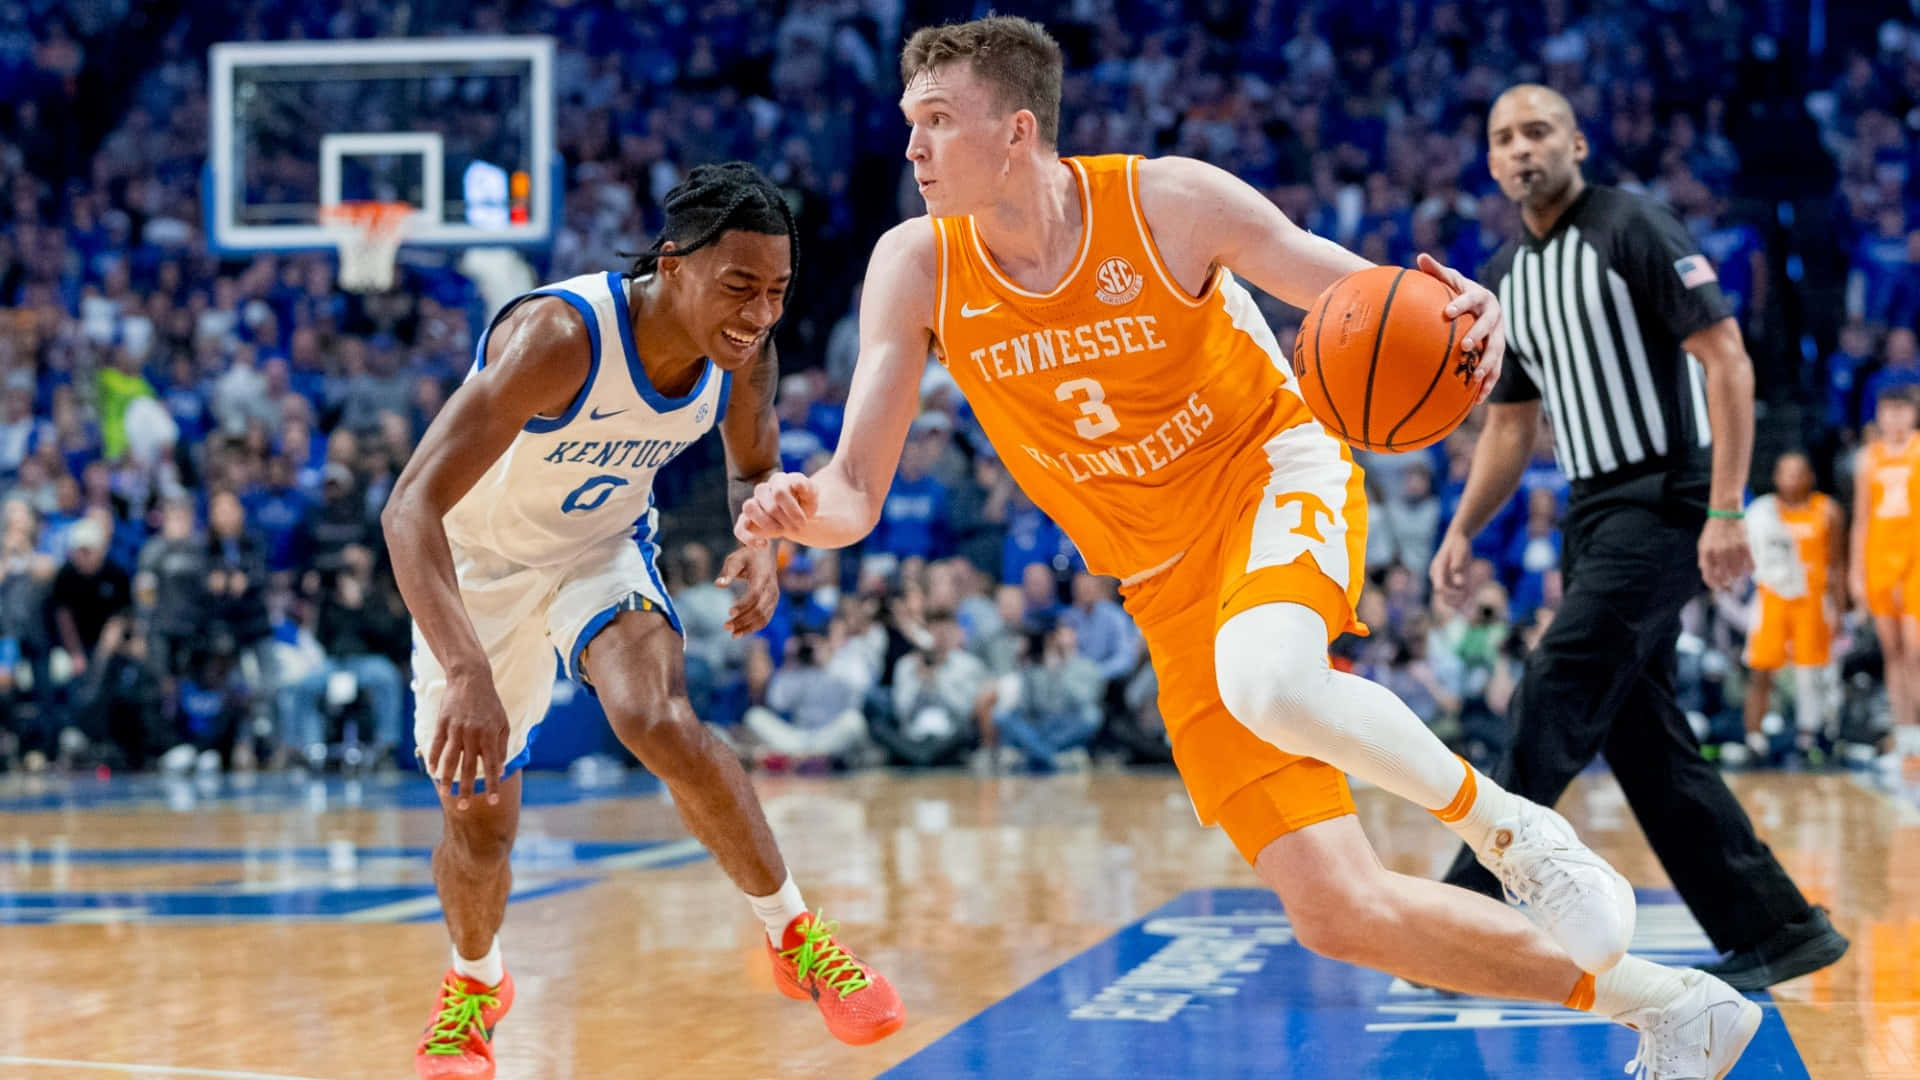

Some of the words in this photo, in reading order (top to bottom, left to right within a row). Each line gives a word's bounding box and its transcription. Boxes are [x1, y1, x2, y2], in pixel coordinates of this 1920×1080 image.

[1098, 259, 1133, 294] SEC
[970, 314, 1167, 383] TENNESSEE
[1054, 377, 1121, 441] 3
[544, 439, 690, 469] KENTUCK
[560, 474, 629, 514] 0
[1275, 490, 1336, 544] T
